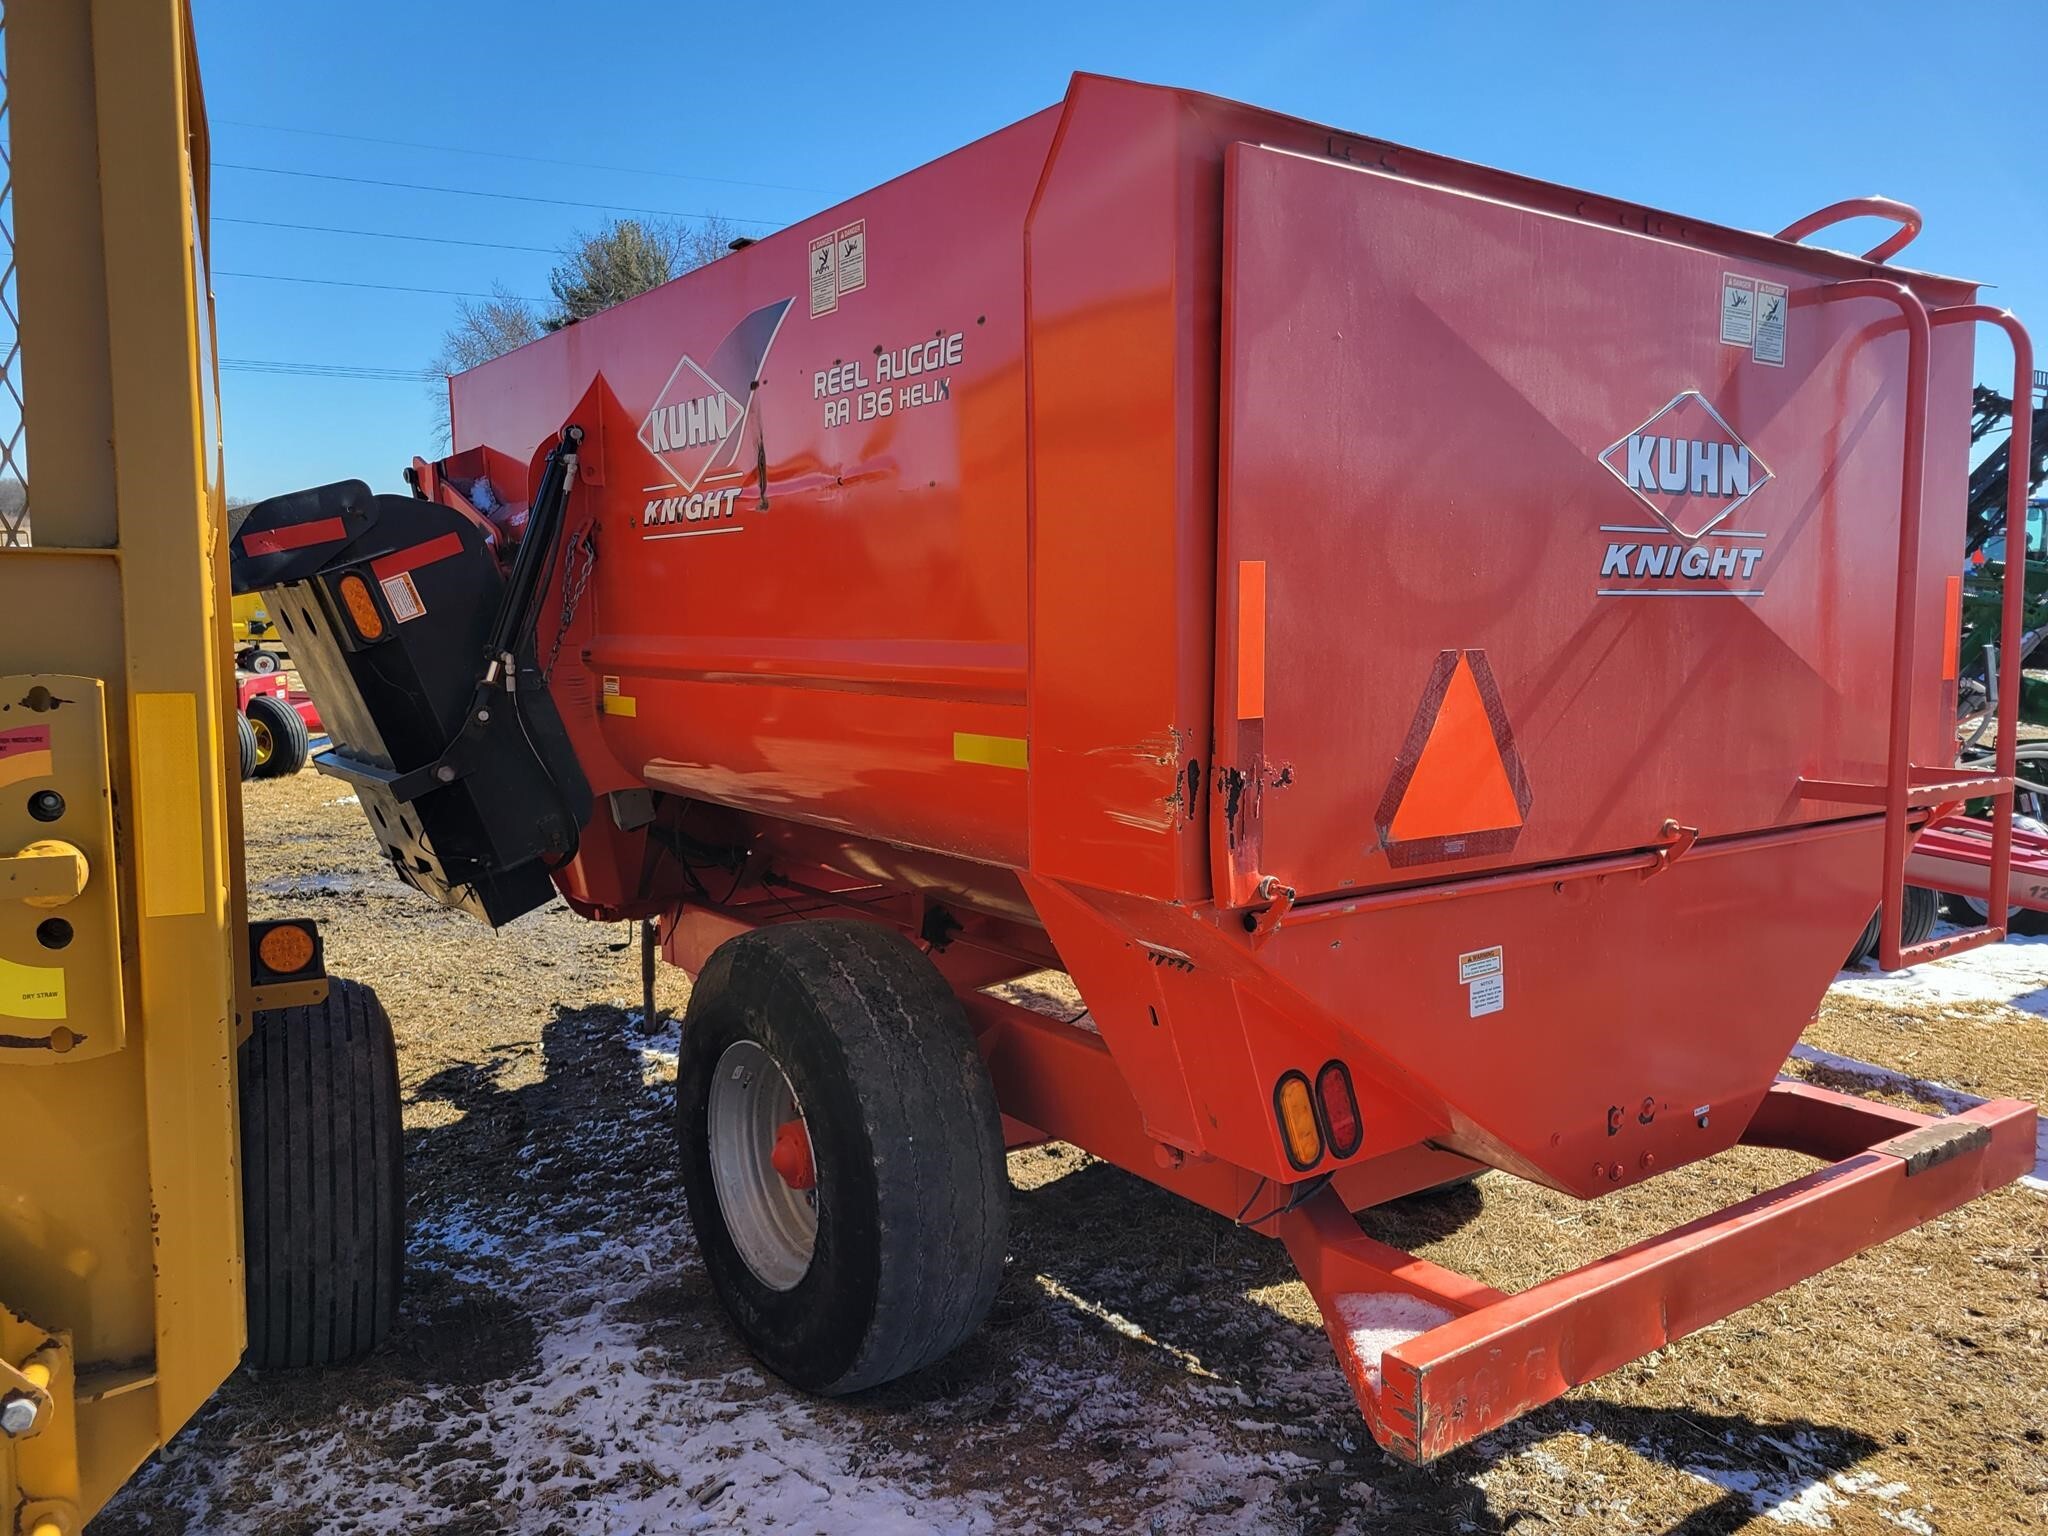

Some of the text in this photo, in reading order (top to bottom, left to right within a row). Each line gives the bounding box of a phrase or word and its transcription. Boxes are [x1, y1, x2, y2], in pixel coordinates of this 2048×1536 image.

[814, 332, 963, 399] REEL AUGGIE
[652, 392, 727, 454] KUHN
[824, 377, 951, 428] RA 136 HELIX
[1627, 434, 1750, 496] KUHN
[643, 487, 742, 526] KNIGHT
[1601, 544, 1763, 579] KNIGHT
[1472, 950, 1495, 961] WARNING
[36, 991, 58, 999] STRAW
